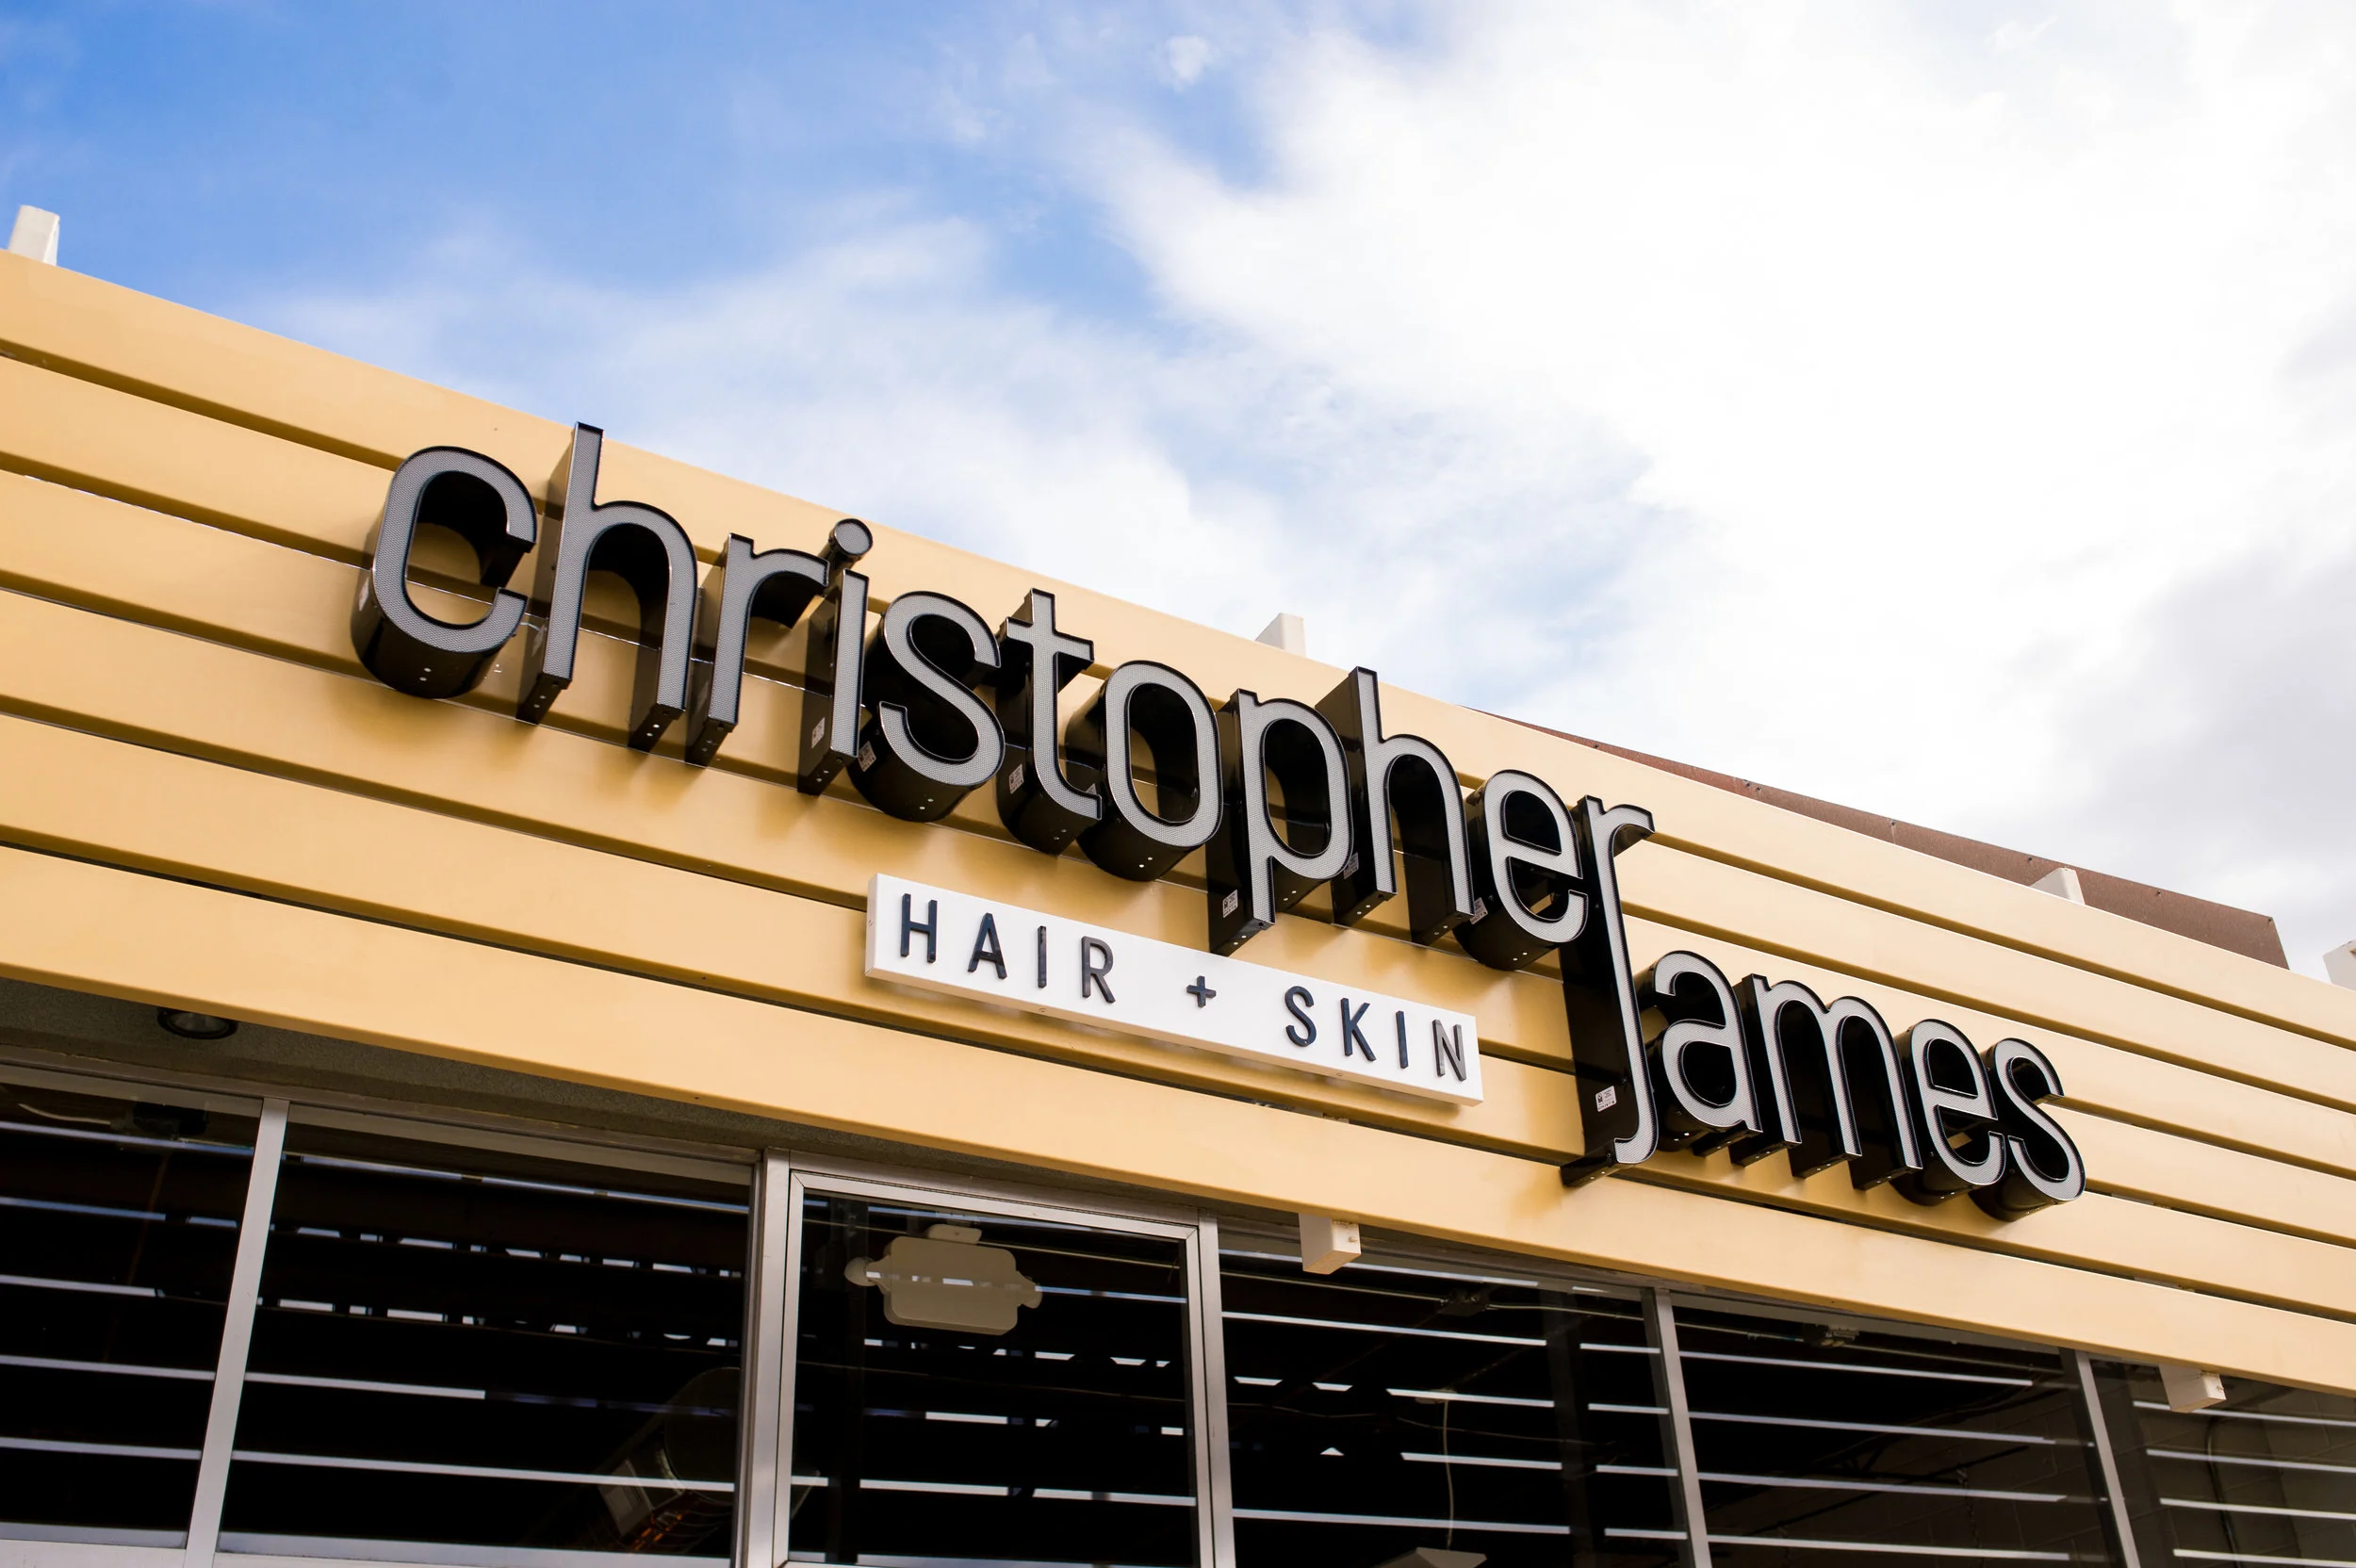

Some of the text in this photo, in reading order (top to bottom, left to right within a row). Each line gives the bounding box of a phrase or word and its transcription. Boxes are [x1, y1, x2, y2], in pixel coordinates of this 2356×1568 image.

[371, 420, 1656, 961] christopher
[900, 892, 1467, 1083] HAIR + SKIN
